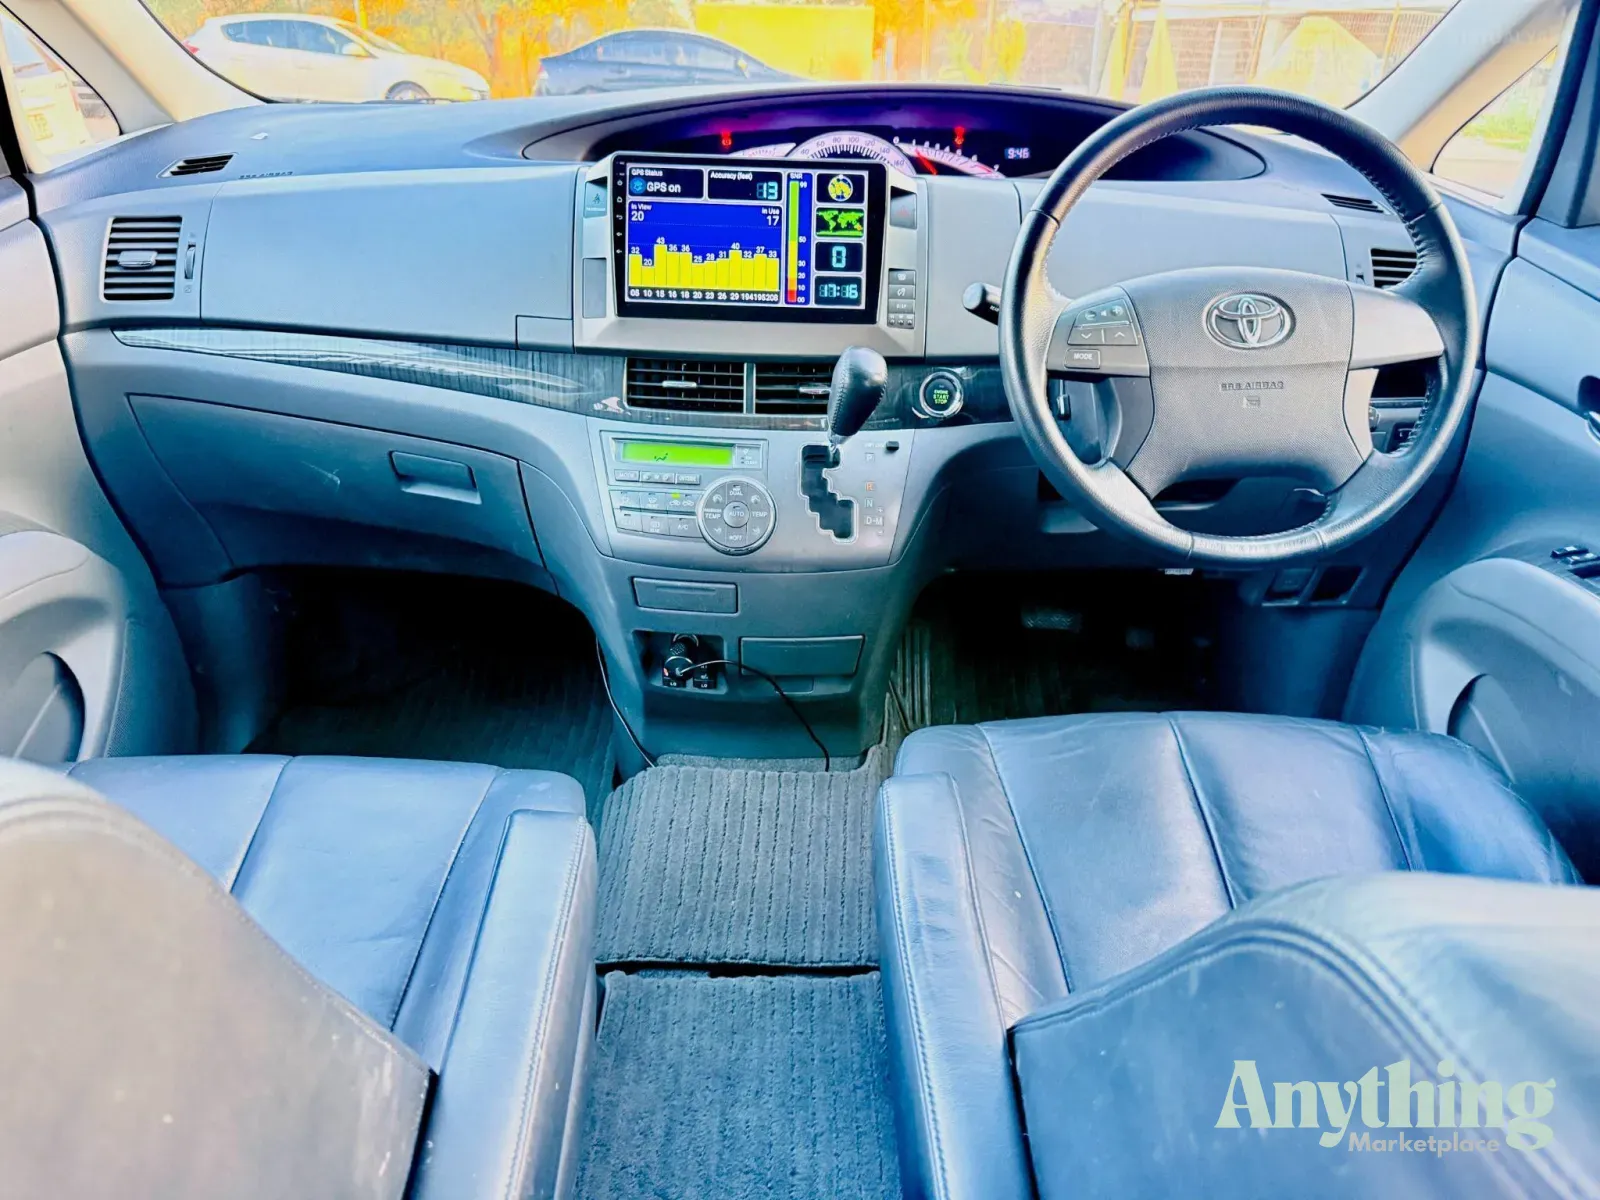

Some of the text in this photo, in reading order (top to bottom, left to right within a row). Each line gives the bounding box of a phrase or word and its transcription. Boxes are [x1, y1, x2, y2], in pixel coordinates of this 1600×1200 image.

[832, 136, 842, 144] 80
[848, 136, 860, 144] 100
[864, 139, 876, 147] 120
[879, 146, 890, 154] 140
[893, 159, 905, 167] 160
[1007, 147, 1030, 160] 9:46
[631, 168, 663, 177] GPS Status
[710, 171, 753, 181] Accuracy (feet)
[790, 172, 803, 180] SNR
[646, 181, 681, 193] GPS on
[761, 182, 778, 200] 13
[631, 211, 645, 221] 20
[766, 215, 780, 226] 17
[656, 237, 665, 245] 43
[631, 246, 640, 254] 32
[731, 242, 740, 250] 40
[756, 246, 765, 254] 37
[706, 253, 715, 261] 28
[719, 251, 727, 259] 31
[743, 250, 753, 258] 32
[768, 250, 777, 258] 33
[832, 246, 846, 268] 0
[643, 258, 653, 266] 20
[693, 255, 703, 263] 25
[643, 289, 653, 297] 10
[693, 291, 703, 299] 20
[730, 292, 740, 300] 29
[741, 293, 753, 301] 194
